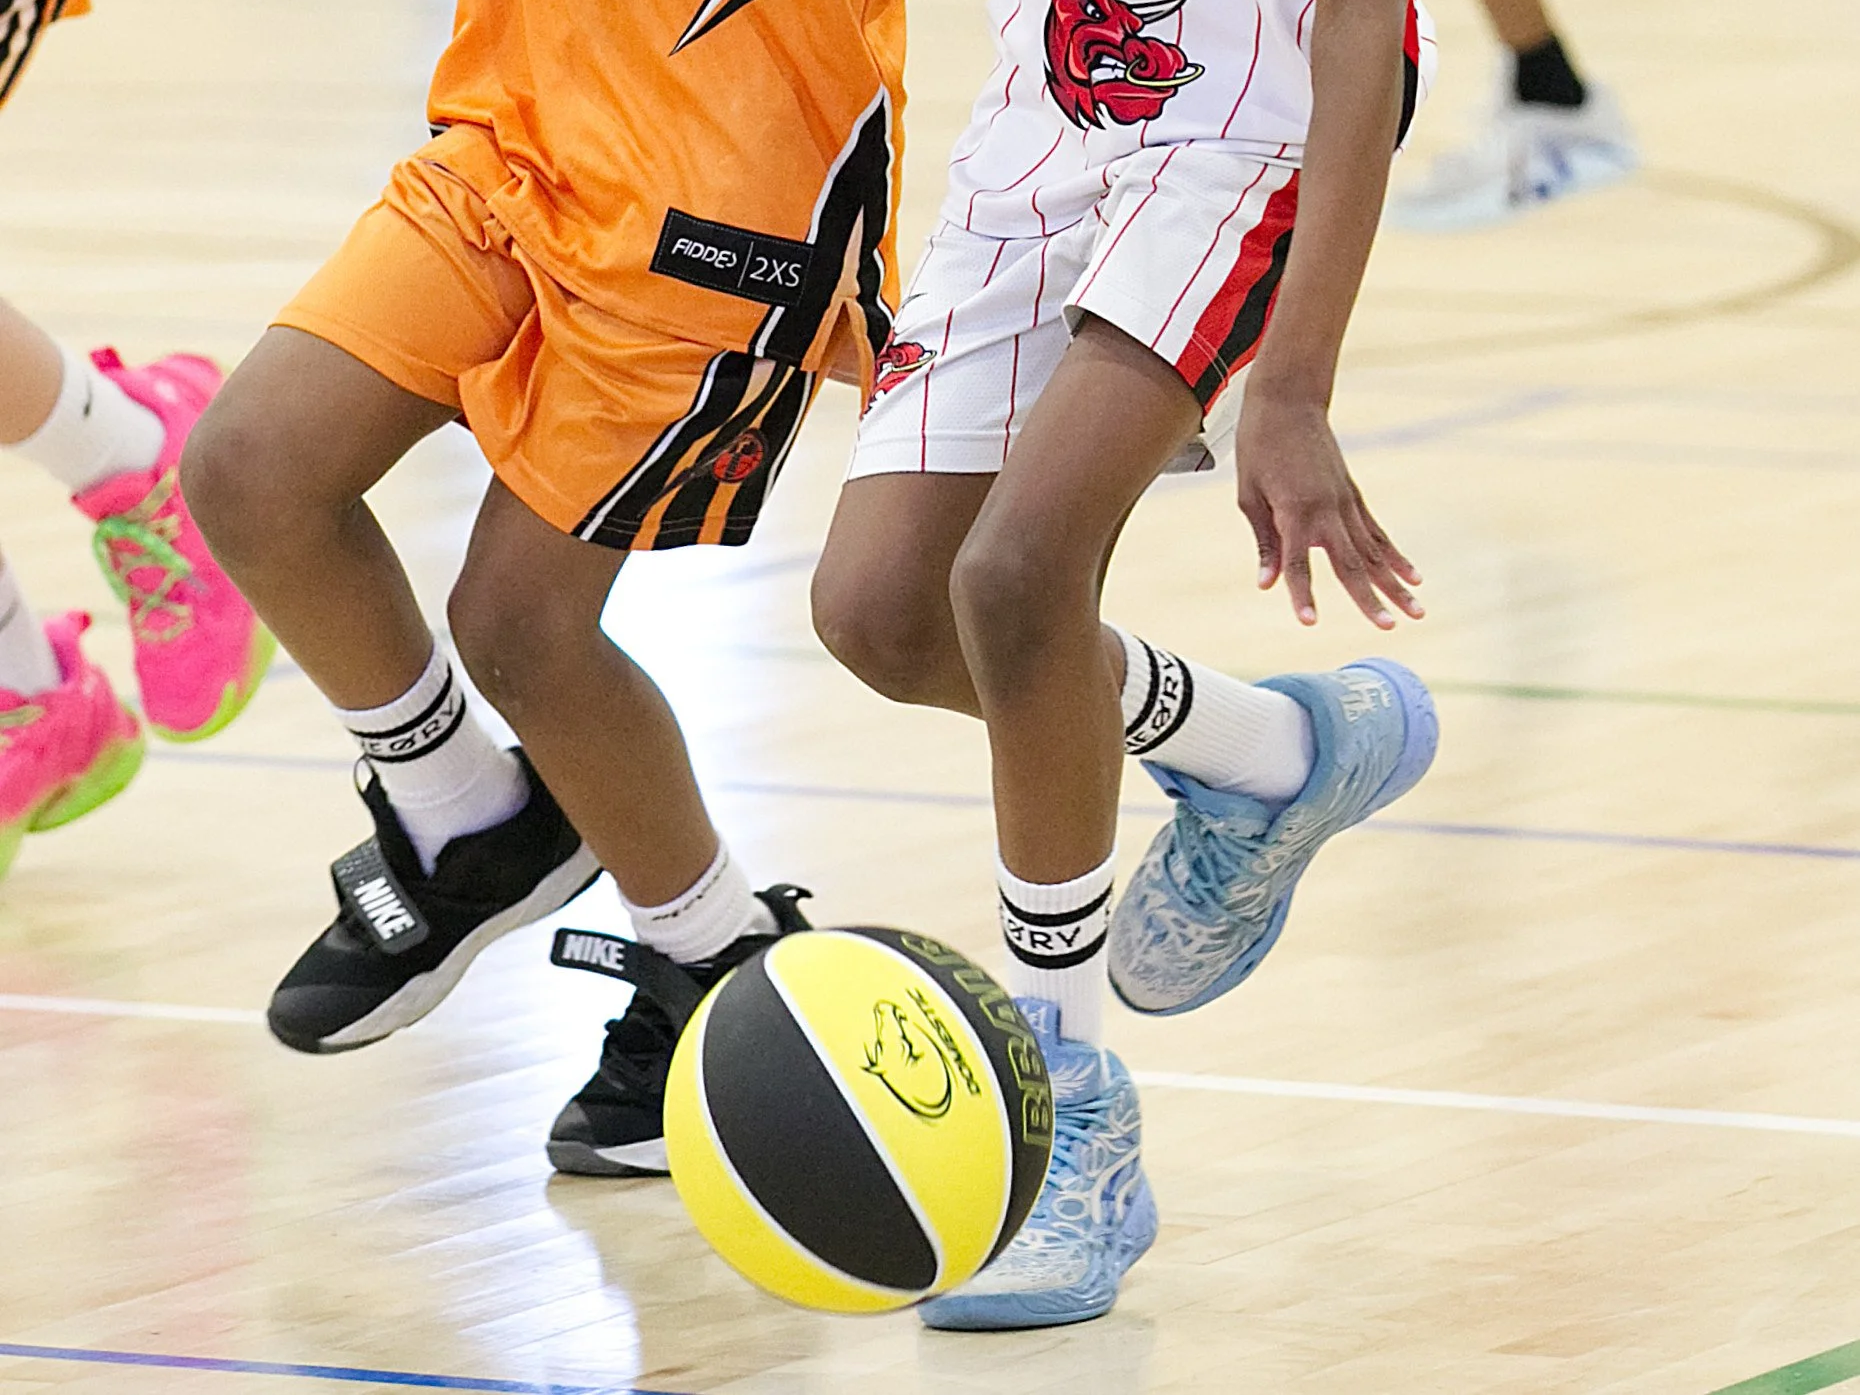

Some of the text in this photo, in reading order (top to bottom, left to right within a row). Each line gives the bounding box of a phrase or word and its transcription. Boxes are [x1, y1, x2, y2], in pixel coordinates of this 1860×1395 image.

[749, 256, 802, 288] 2XS
[353, 875, 416, 940] NIKE
[562, 933, 625, 971] NIKE
